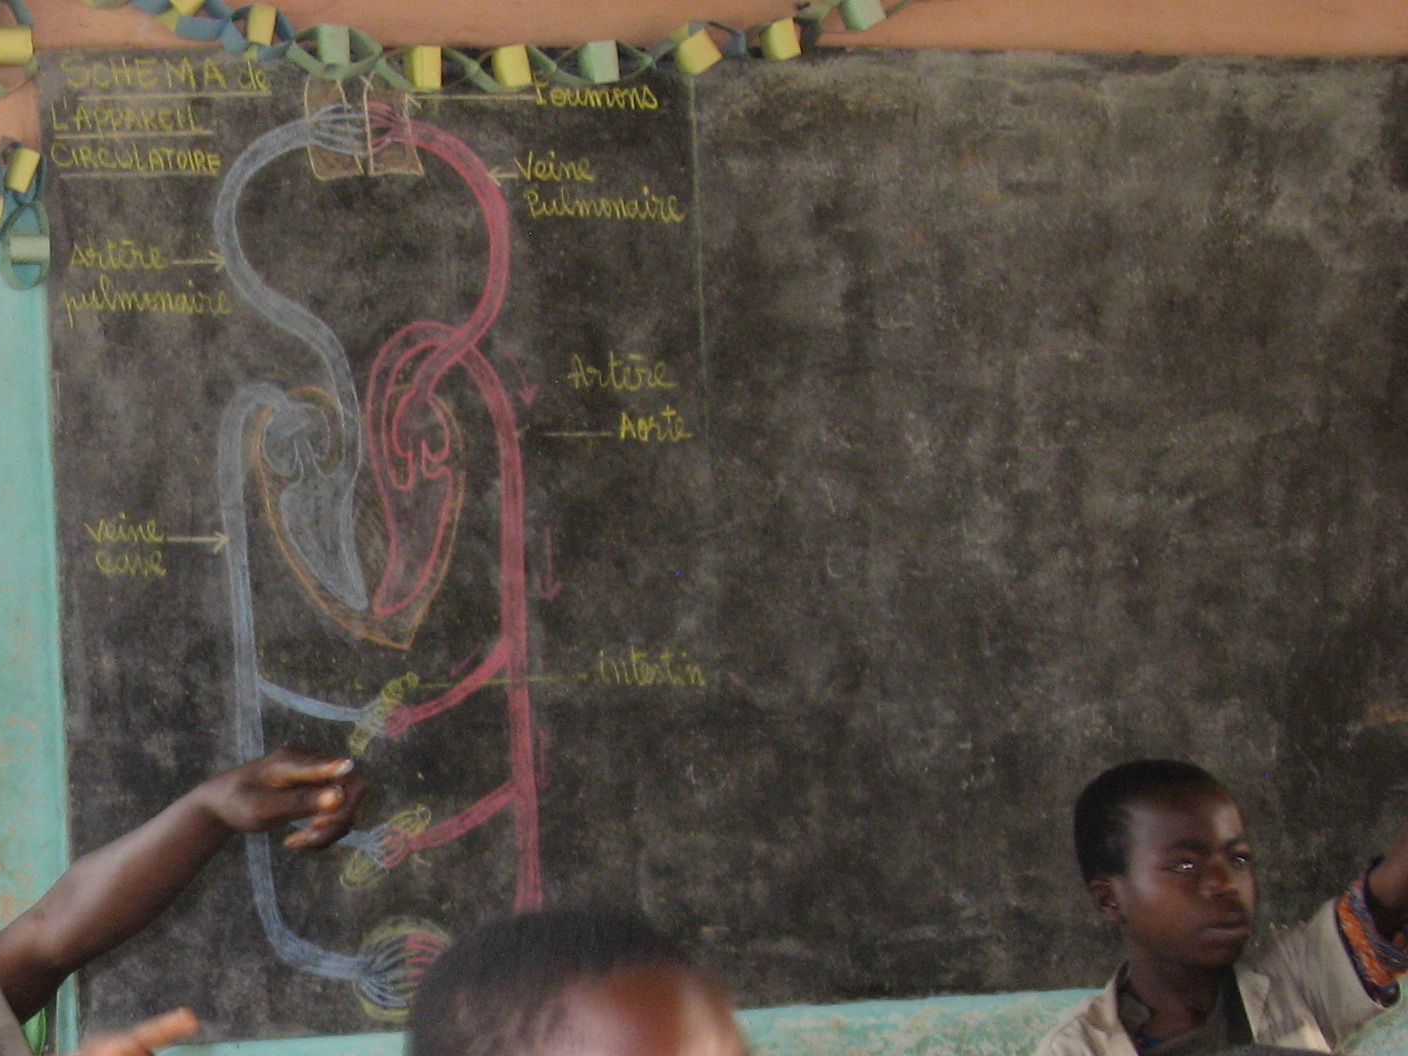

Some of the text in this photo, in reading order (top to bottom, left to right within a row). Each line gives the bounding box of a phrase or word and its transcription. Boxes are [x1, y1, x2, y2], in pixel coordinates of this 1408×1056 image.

[61, 55, 227, 89] SCHEMA
[50, 97, 204, 138] L'APPAREIL
[50, 142, 223, 171] CIRCULATOIRE
[512, 150, 596, 181] Veine
[523, 185, 686, 222] Pulmonaire
[619, 404, 694, 442] Aorte
